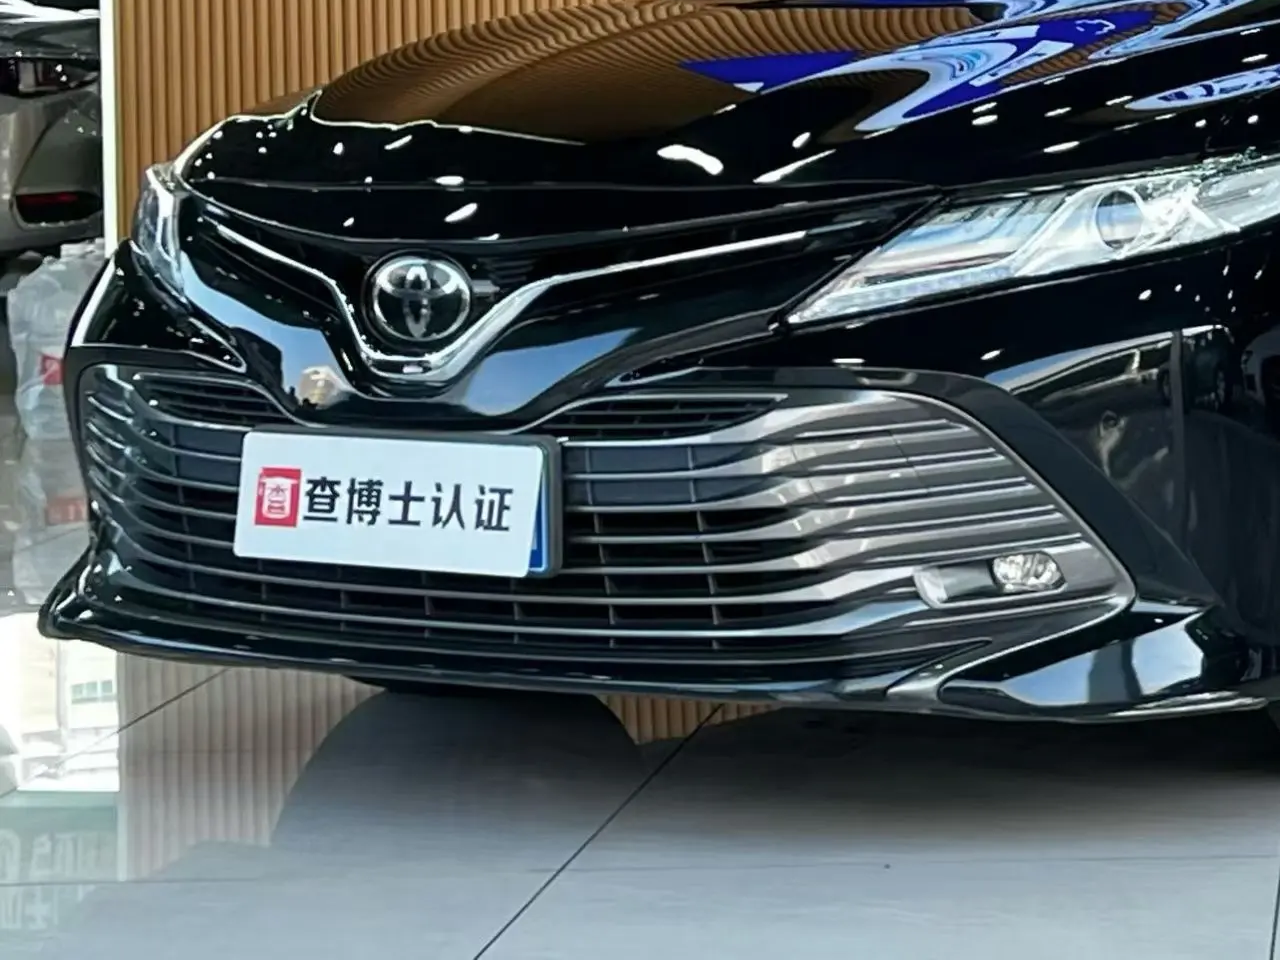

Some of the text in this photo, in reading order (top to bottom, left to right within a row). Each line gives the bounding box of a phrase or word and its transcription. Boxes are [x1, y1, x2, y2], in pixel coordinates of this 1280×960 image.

[302, 476, 514, 532] 查博士认证
